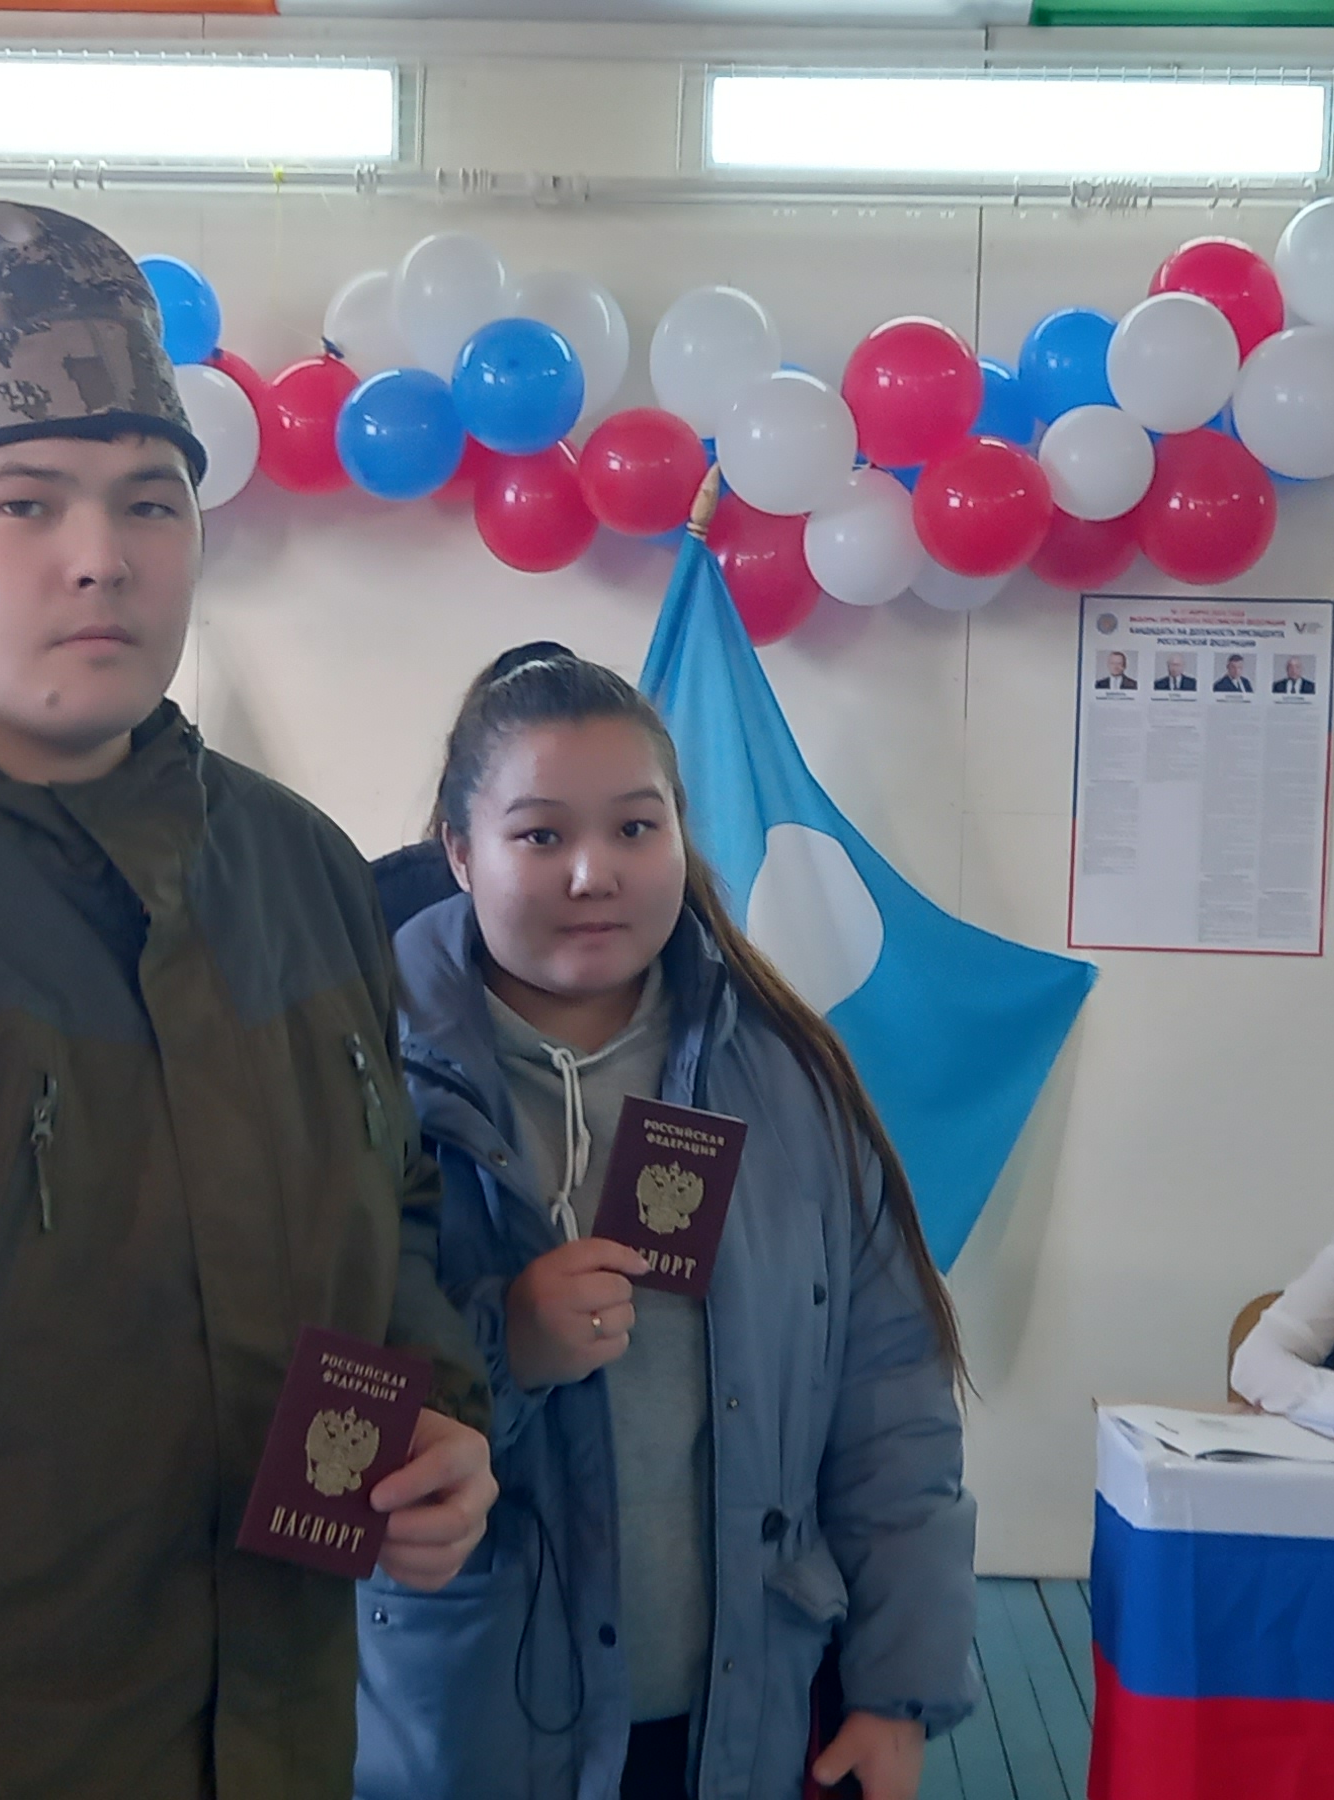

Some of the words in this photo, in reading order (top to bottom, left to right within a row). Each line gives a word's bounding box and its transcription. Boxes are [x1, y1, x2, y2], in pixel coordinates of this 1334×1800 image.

[643, 1118, 725, 1147] РОССИЙСКАЯ
[646, 1132, 717, 1158] ФЕДЕРАЦИЯ
[639, 1247, 697, 1280] ПОРТ
[320, 1352, 408, 1389] РОССИЙСКАЯ
[322, 1369, 398, 1402] ФЕДЕРАЦИЯ
[270, 1506, 365, 1553] ПАСПОРТ
